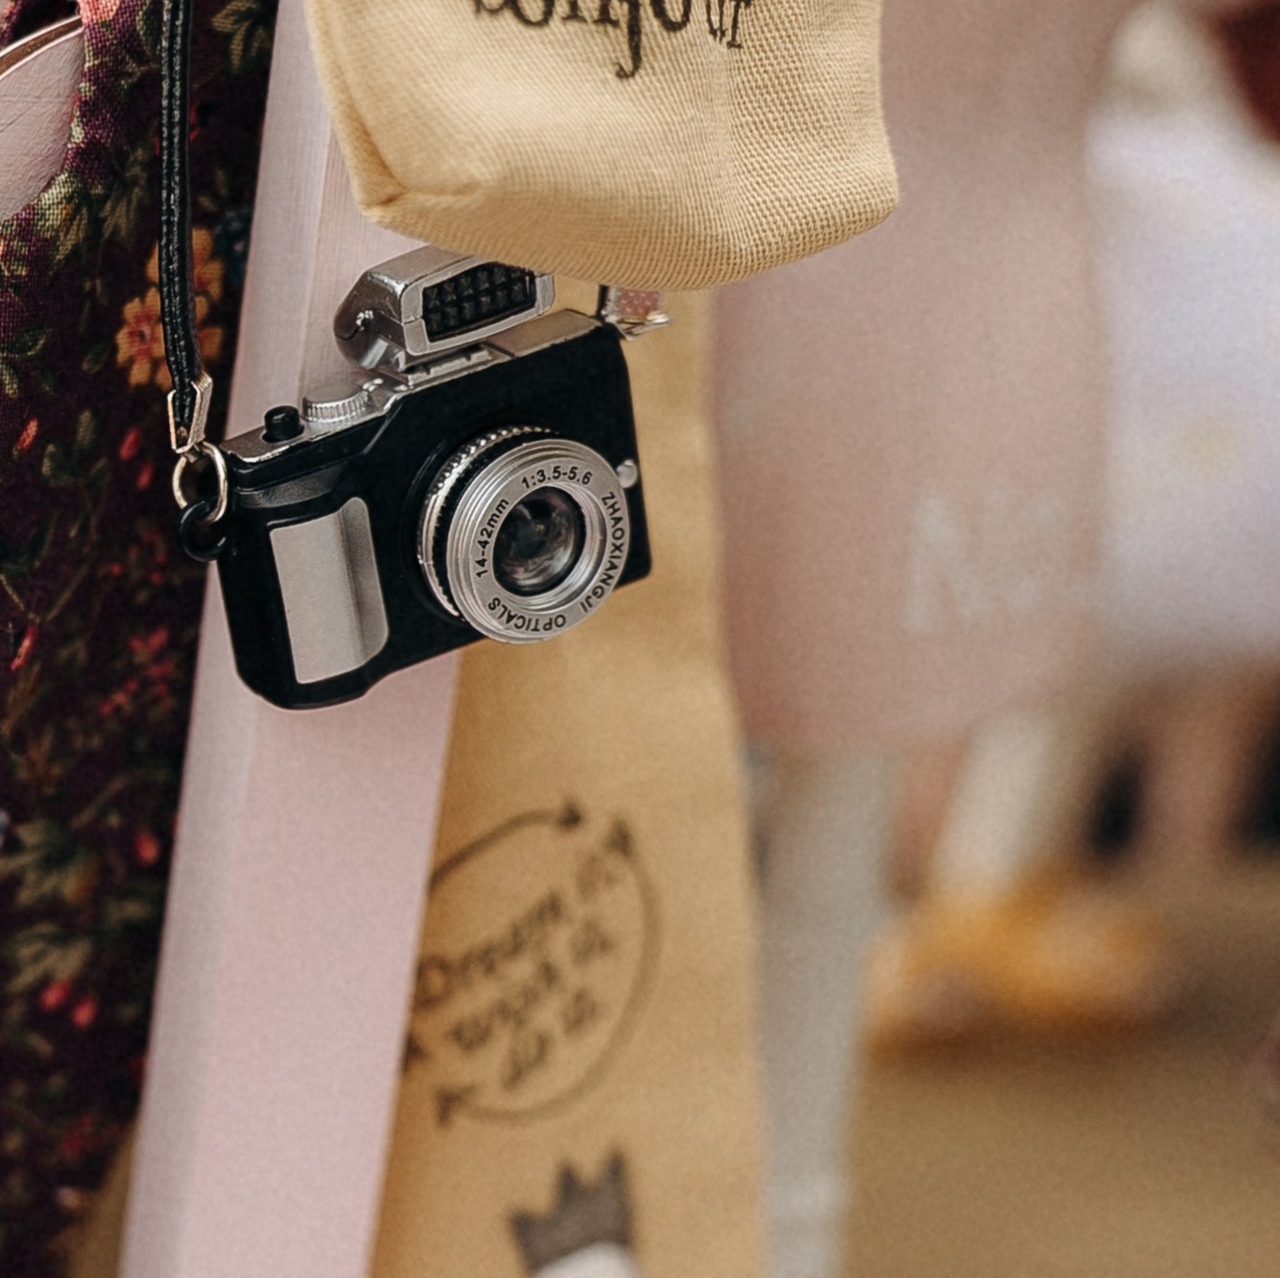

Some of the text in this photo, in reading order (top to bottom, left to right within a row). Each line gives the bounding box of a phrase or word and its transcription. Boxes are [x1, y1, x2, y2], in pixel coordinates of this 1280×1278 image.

[475, 465, 593, 578] 14-42mm 1:3.5-5.6
[487, 491, 626, 632] ZHAOXIANGJI OPTICALS
